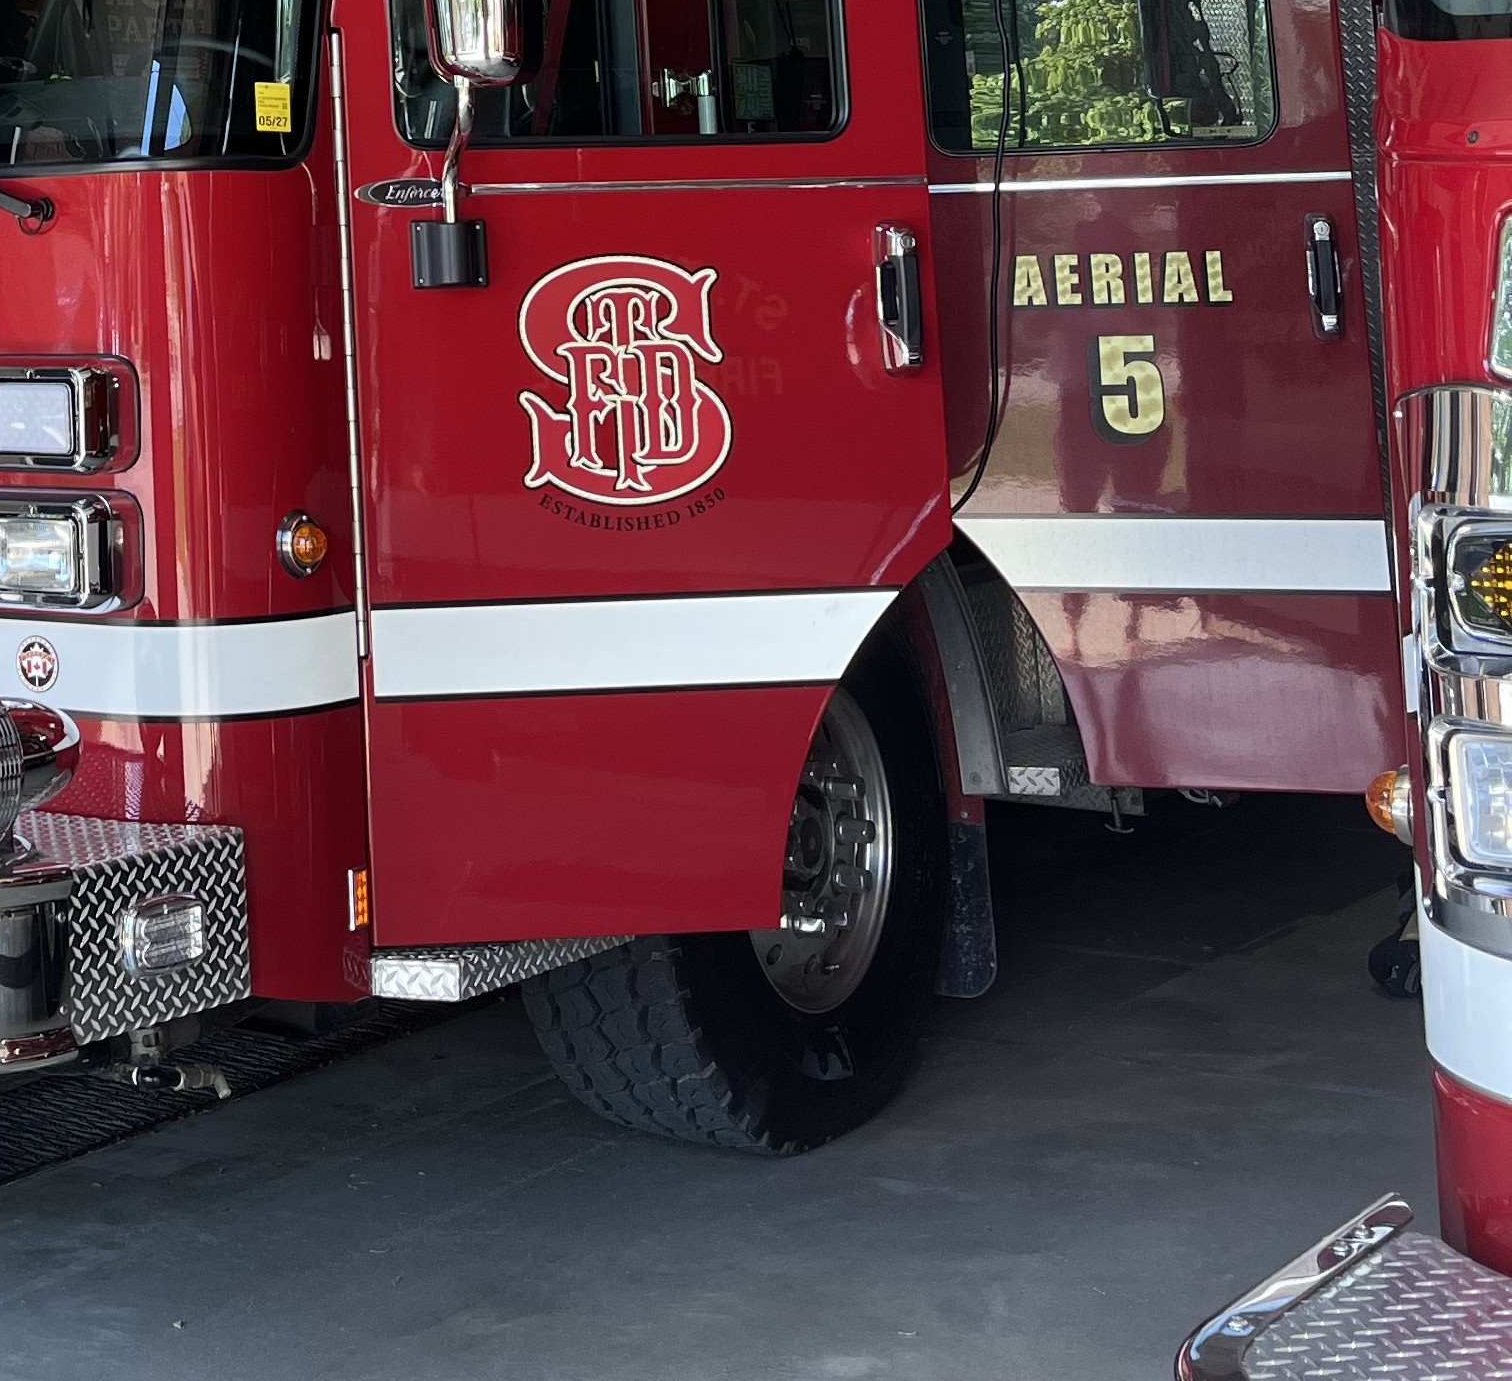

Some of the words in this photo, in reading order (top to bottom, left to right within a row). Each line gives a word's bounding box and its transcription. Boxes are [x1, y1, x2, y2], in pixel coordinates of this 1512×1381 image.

[258, 115, 288, 127] 05/27
[1007, 250, 1234, 310] AERIAL
[1089, 334, 1167, 446] 5
[538, 492, 682, 533] ESTABLISHED
[686, 486, 727, 519] 1850
